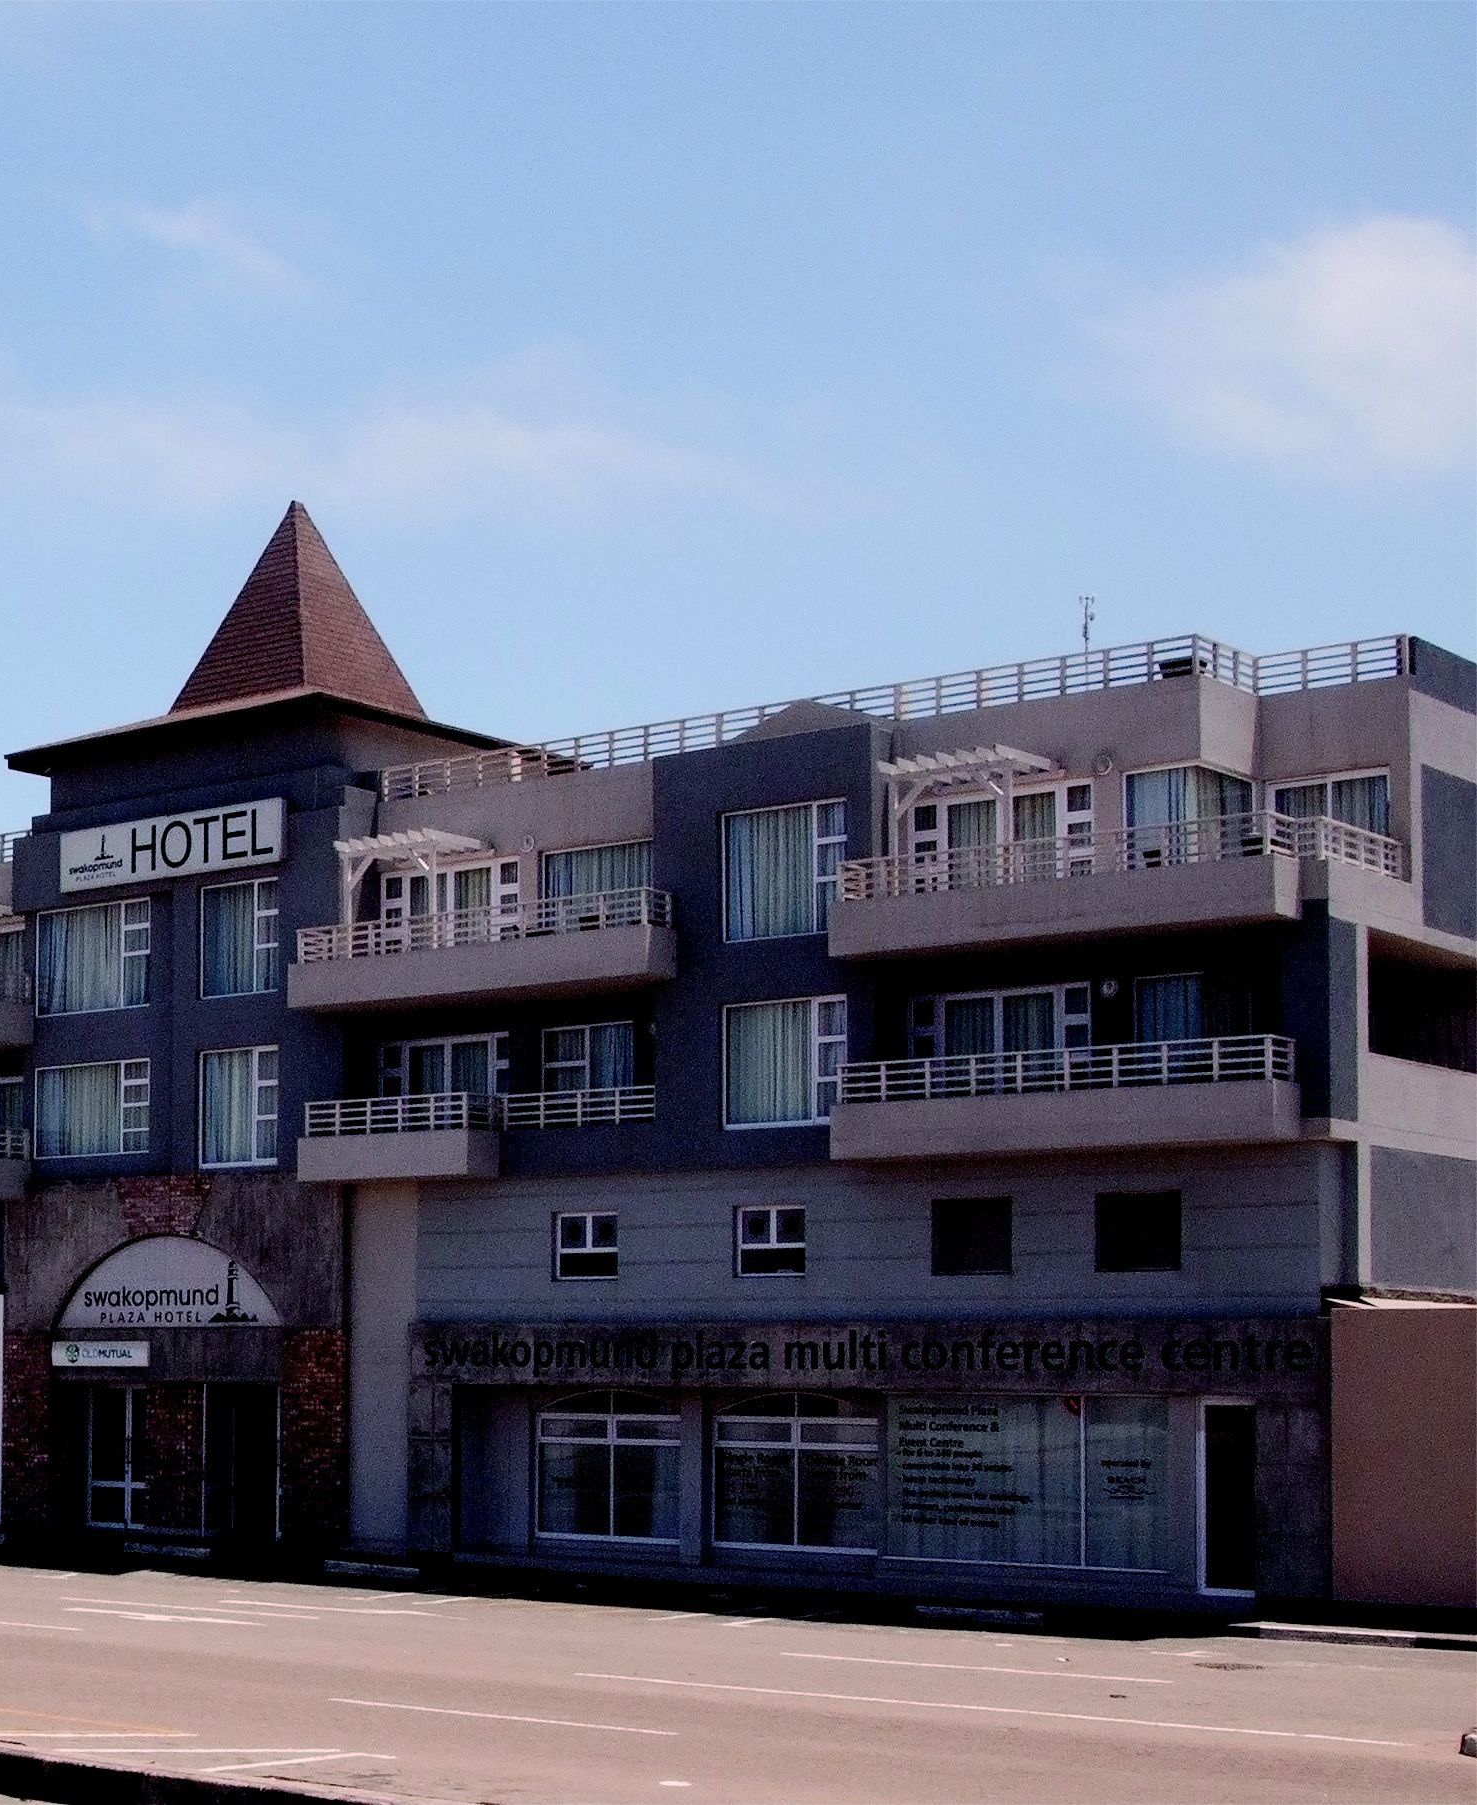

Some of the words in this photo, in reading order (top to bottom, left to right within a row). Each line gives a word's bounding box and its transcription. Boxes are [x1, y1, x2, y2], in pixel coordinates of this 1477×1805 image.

[130, 808, 273, 874] HOTEL
[69, 857, 123, 876] swakopmund
[96, 871, 116, 880] HOTEL
[84, 1284, 219, 1311] swakopmund
[101, 1312, 146, 1324] PLAZA
[154, 1311, 202, 1324] HOTEL
[424, 1330, 658, 1378] swakopmund
[671, 1330, 769, 1379] plaza
[784, 1330, 887, 1370] multi
[901, 1330, 1144, 1372] conference
[1161, 1333, 1312, 1372] centre
[898, 1404, 968, 1417] Swakopmund
[971, 1404, 998, 1416] Plaza
[899, 1420, 926, 1431] Multi
[929, 1420, 988, 1432] Conference
[990, 1421, 999, 1432] &
[899, 1436, 927, 1447] Event
[929, 1437, 964, 1448] Centre
